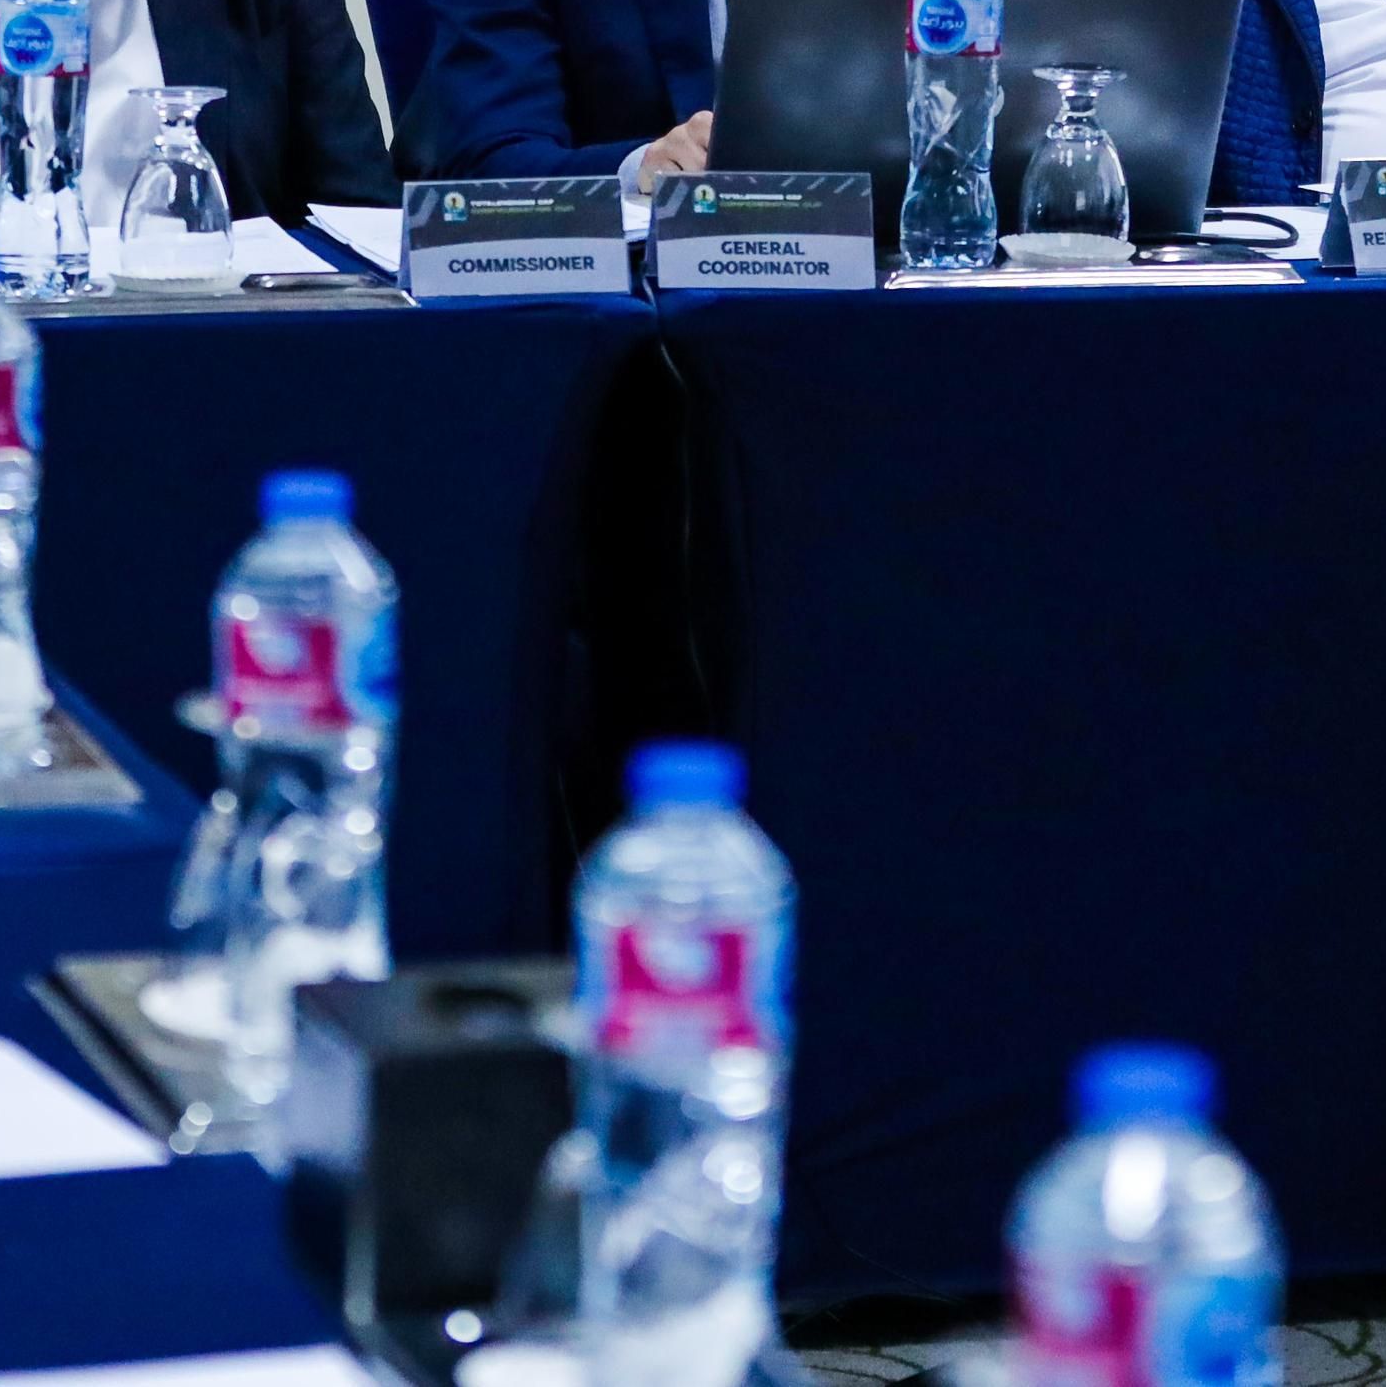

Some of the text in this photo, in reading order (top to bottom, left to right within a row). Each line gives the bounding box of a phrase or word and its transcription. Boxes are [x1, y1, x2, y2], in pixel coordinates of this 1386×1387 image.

[721, 241, 805, 255] GENERAL
[448, 255, 594, 273] COMMISSIONER
[698, 260, 830, 275] COORDINATOR
